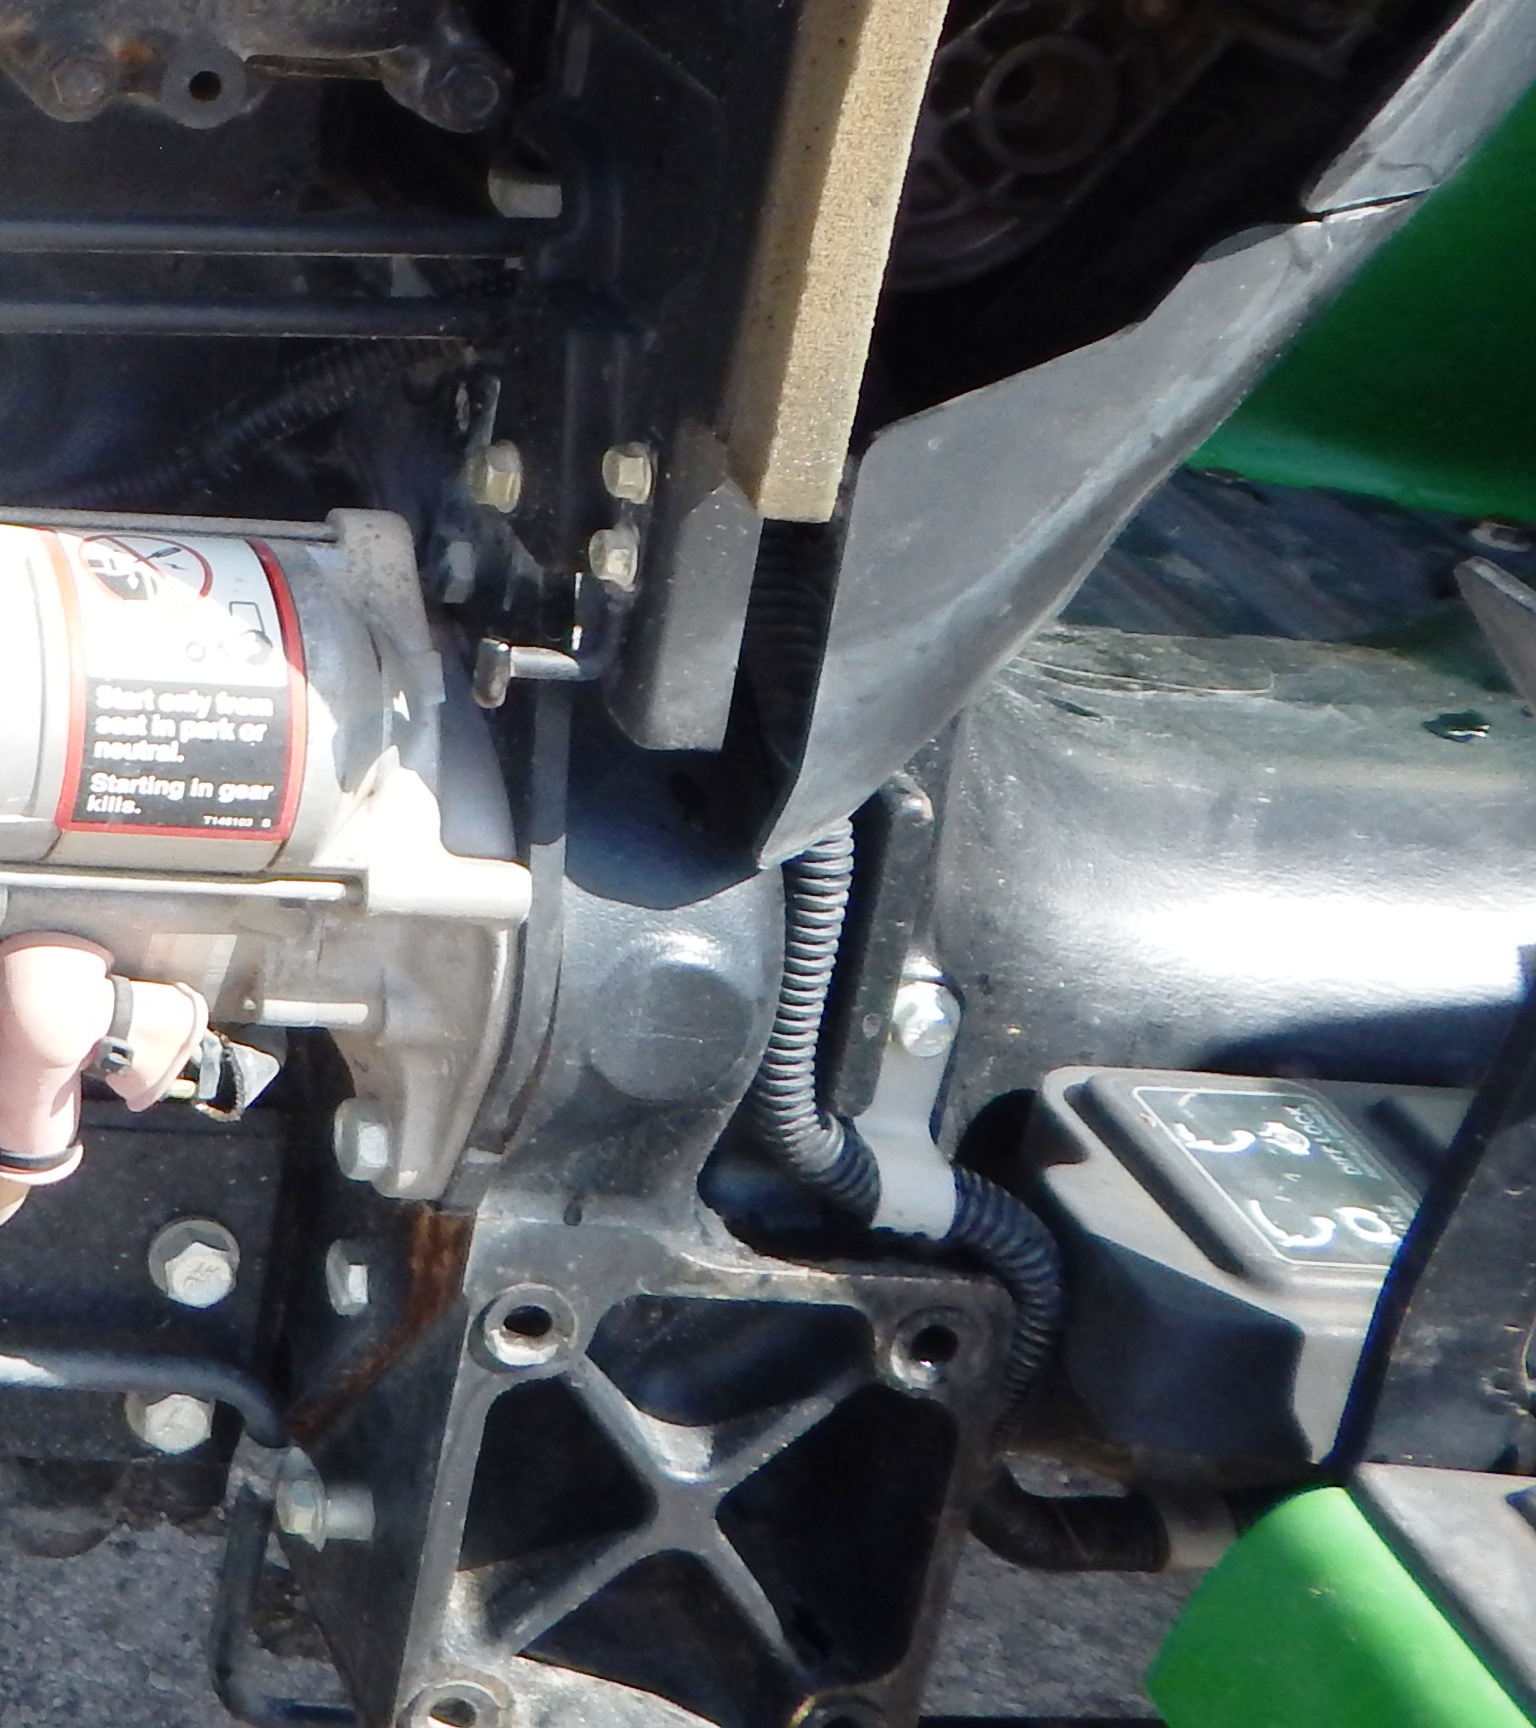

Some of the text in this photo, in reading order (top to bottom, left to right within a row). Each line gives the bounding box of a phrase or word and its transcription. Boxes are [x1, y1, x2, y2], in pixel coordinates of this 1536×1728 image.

[95, 684, 275, 719] Start only from
[95, 713, 268, 744] seat in park or
[94, 739, 185, 763] neutral.
[90, 772, 275, 804] Starting in gear
[86, 794, 142, 815] kills.
[1283, 1105, 1332, 1144] LOCK
[1322, 1144, 1364, 1176] DIFF
